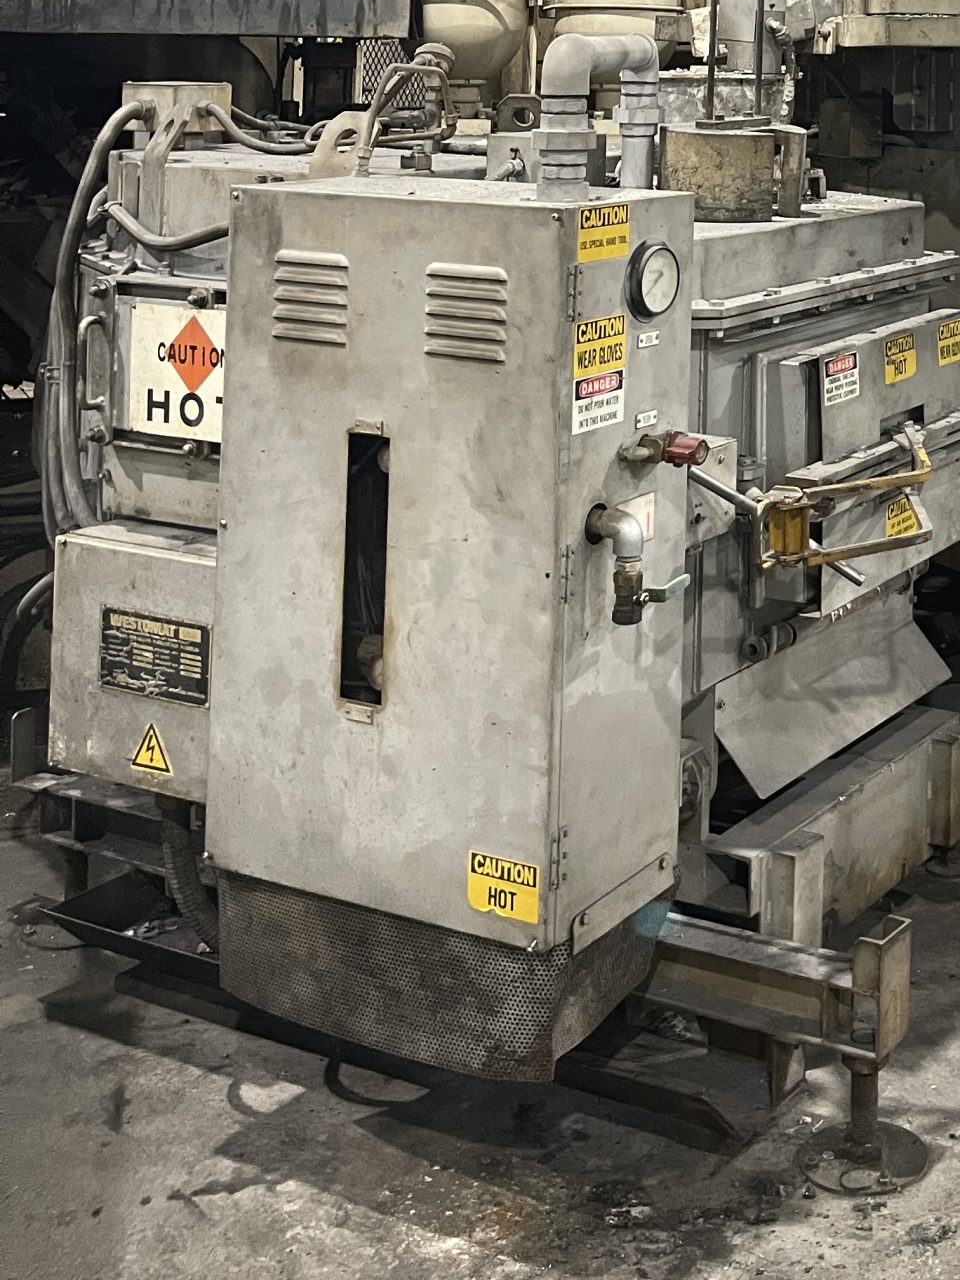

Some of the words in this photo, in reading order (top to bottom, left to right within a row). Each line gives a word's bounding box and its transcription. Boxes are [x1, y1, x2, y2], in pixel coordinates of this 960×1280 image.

[582, 205, 627, 228] CAUTION
[578, 316, 624, 343] CAUTION
[577, 348, 597, 369] WEAR
[599, 342, 623, 365] GLOVES
[886, 335, 913, 356] CAUTION
[830, 357, 853, 373] DANGER
[895, 358, 907, 376] HOT
[581, 376, 617, 395] DANGER
[474, 854, 534, 886] CAUTION
[488, 886, 517, 911] HOT
